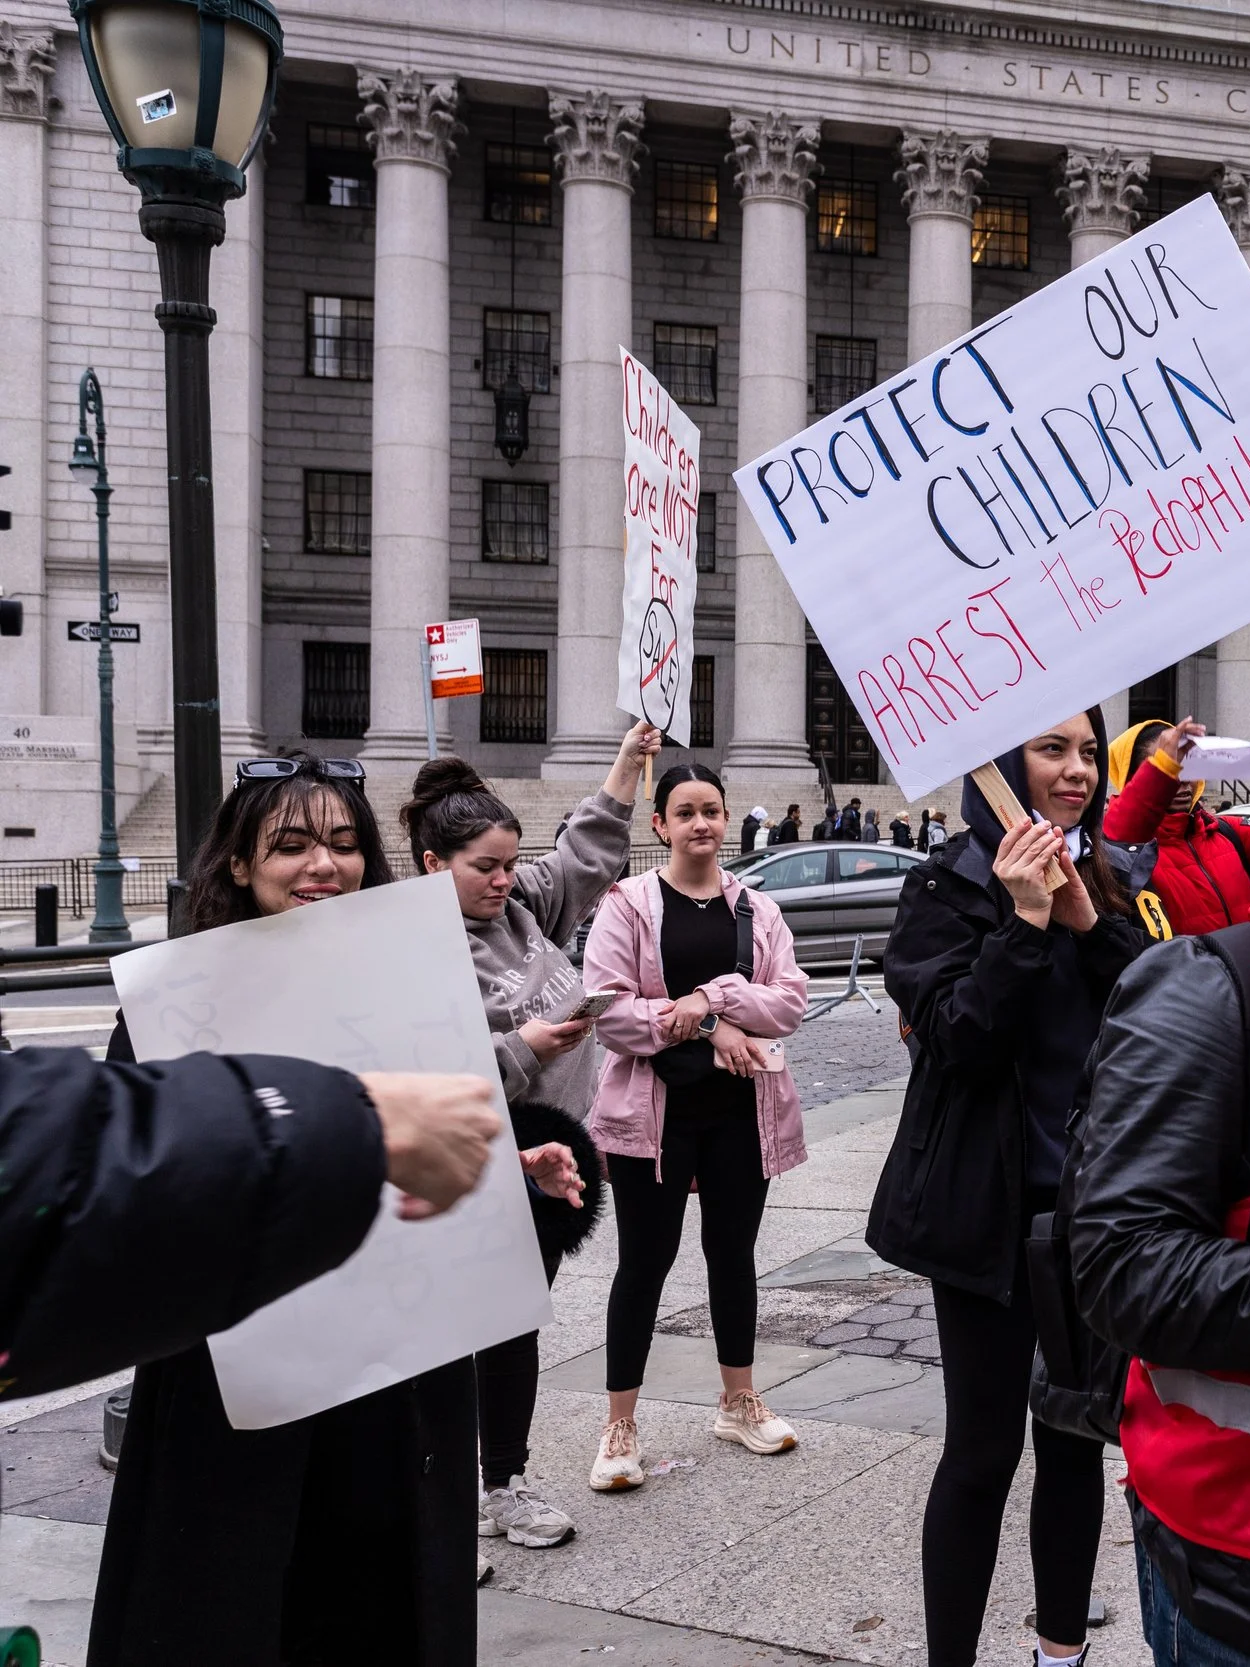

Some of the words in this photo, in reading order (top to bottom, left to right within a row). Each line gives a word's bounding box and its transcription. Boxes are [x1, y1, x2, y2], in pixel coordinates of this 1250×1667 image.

[726, 26, 931, 76] UNITED
[1003, 62, 1170, 104] STATES
[624, 355, 698, 503] Children
[757, 316, 1013, 544] PROTECT
[1084, 244, 1218, 359] OUR
[926, 338, 1235, 569] CHILDREN
[663, 475, 697, 560] NOT
[651, 540, 679, 611] For
[81, 627, 101, 636] ONE
[111, 628, 133, 637] WAY
[643, 610, 677, 709] SALE
[858, 577, 1047, 765] ARREST
[13, 727, 31, 739] 40
